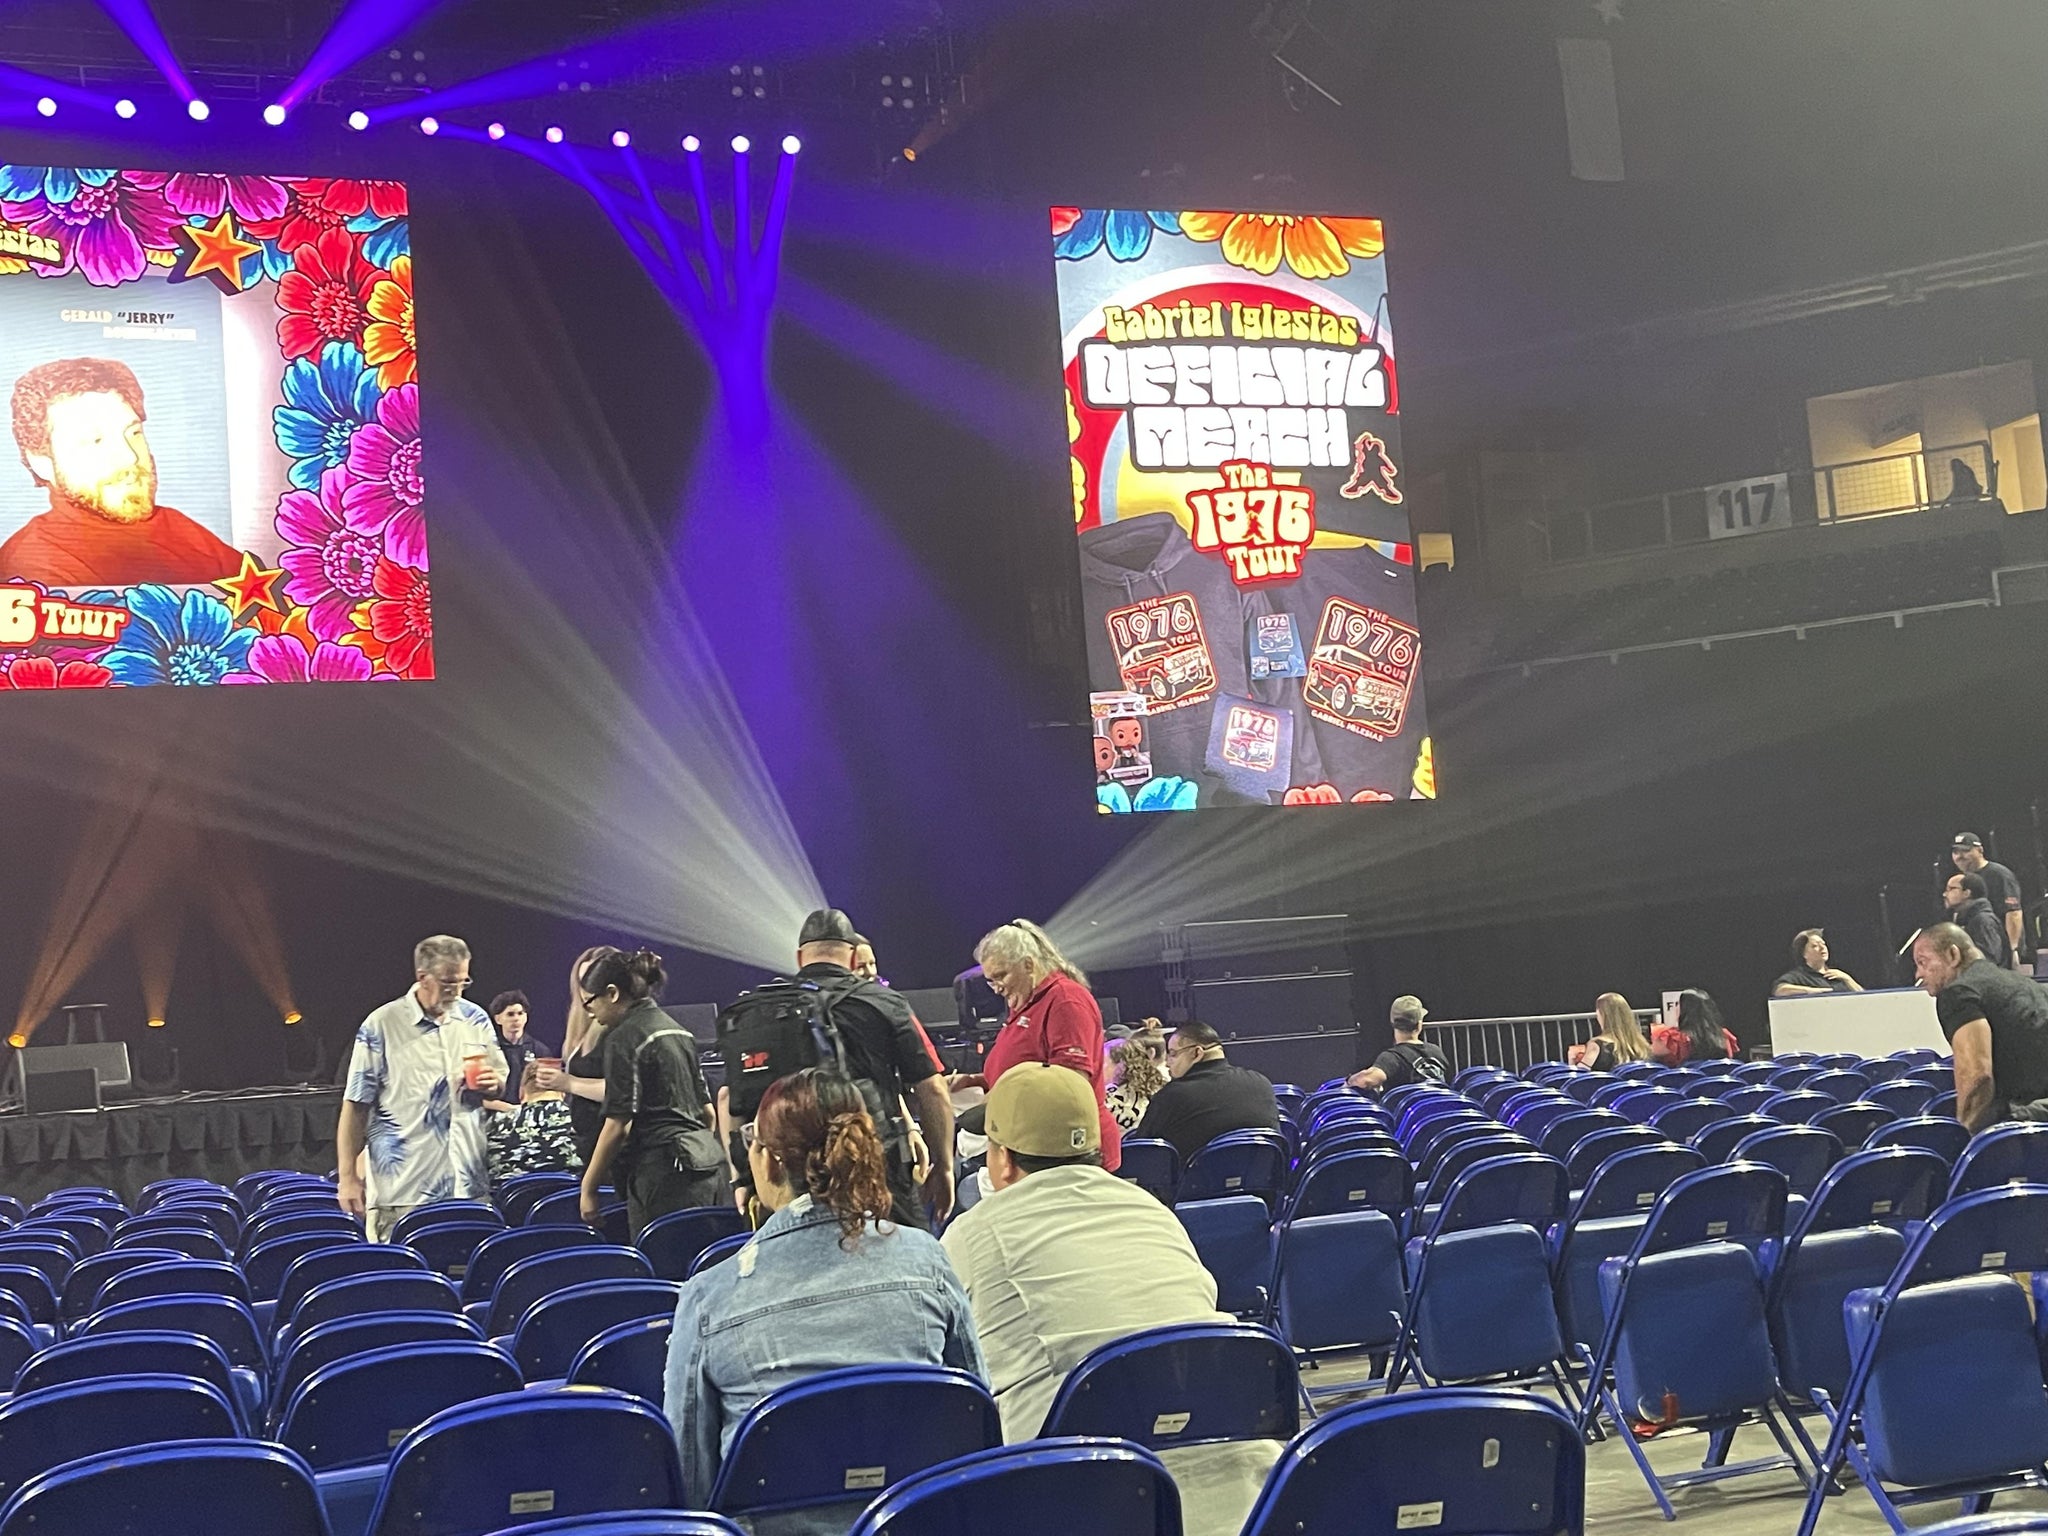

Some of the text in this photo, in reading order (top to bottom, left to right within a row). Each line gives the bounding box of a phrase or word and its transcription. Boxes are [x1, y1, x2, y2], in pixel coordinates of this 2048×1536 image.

[0, 227, 61, 262] sias
[1106, 302, 1357, 344] Gabriel Iglesias
[1084, 345, 1386, 406] OFFICIAL
[1133, 408, 1350, 466] MERCH
[1225, 465, 1268, 487] The
[1191, 490, 1309, 547] 1976
[1718, 484, 1775, 529] 117
[1227, 544, 1301, 579] Tour
[41, 601, 125, 637] Tour
[1139, 598, 1158, 611] THE
[1259, 616, 1287, 628] 1976
[1367, 608, 1389, 623] THE
[1113, 601, 1194, 647] 1976
[1170, 632, 1198, 646] TOUR
[1328, 606, 1413, 667] 1976
[1377, 661, 1407, 681] TOUR
[1233, 711, 1275, 736] 1976
[1311, 709, 1383, 743] GABRIEL IGLESIAS
